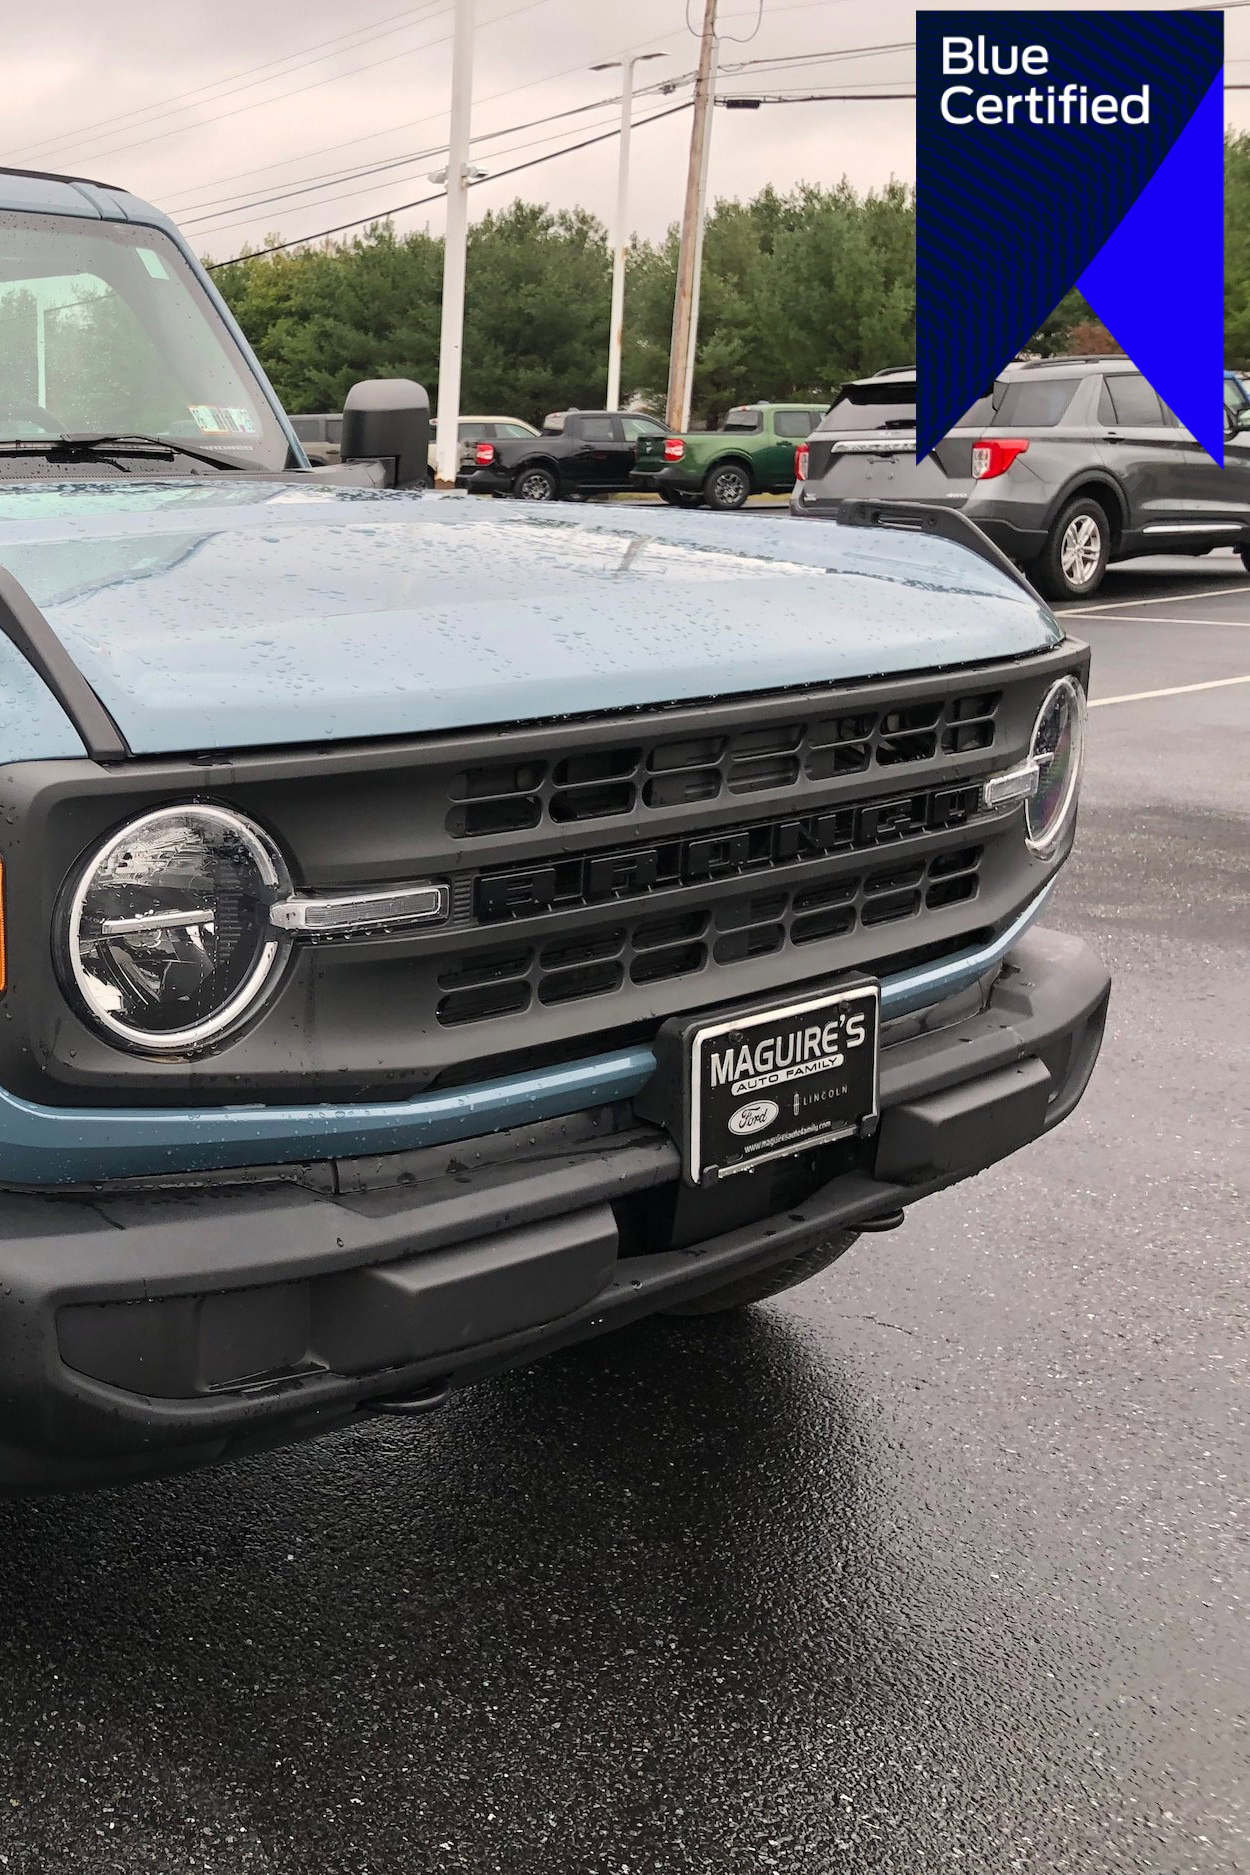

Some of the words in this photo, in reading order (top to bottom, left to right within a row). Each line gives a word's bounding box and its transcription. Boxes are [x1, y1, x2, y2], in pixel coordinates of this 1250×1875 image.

[475, 784, 980, 918] BRONCO
[710, 1013, 866, 1088] MAGUIRE'S
[735, 1073, 780, 1094] AUTO
[785, 1056, 838, 1079] FAMILY
[802, 1085, 849, 1106] LINCOLN
[738, 1106, 769, 1130] Ford
